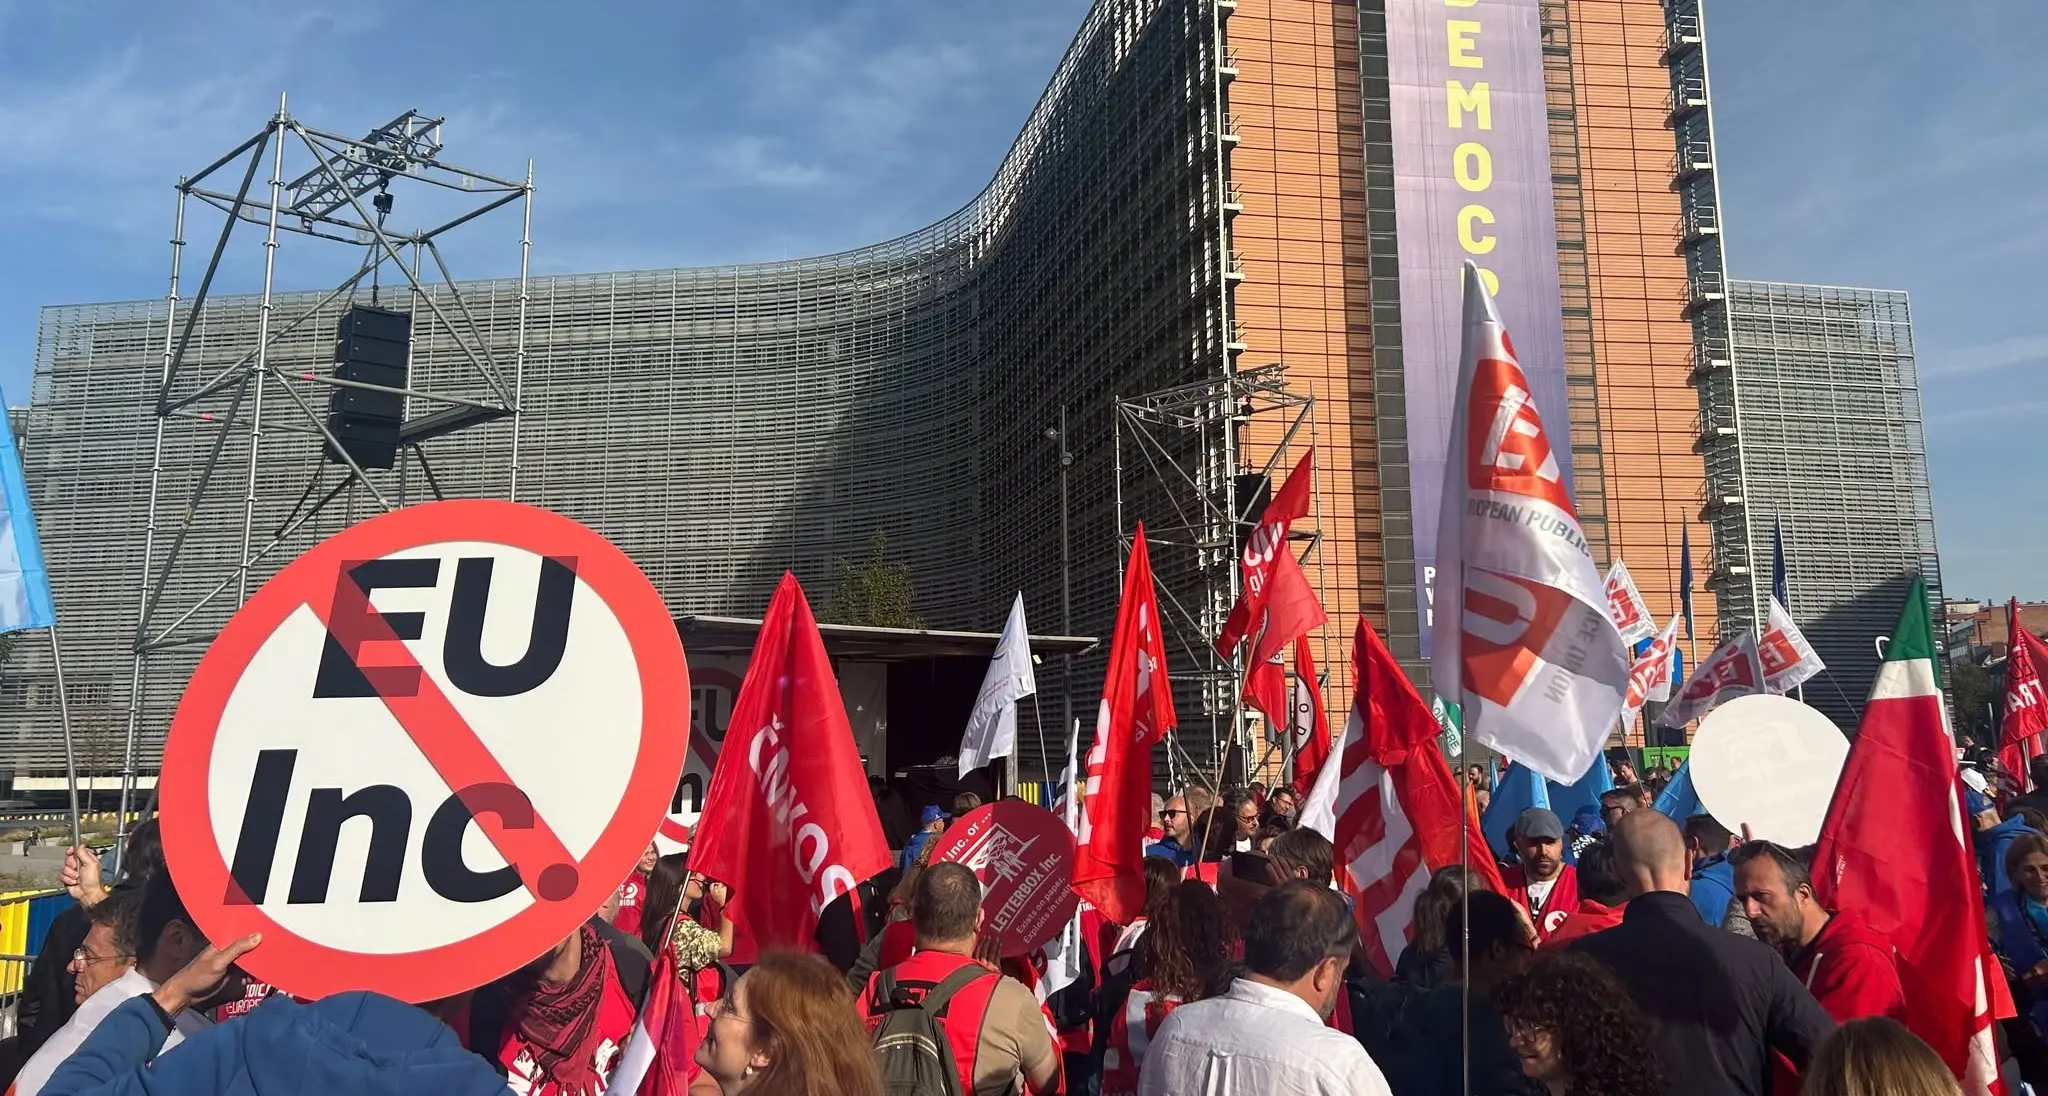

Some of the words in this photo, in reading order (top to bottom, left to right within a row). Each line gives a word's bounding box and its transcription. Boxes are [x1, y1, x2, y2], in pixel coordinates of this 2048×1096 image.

[312, 555, 579, 699] EU
[222, 748, 580, 906] Inc.
[967, 822, 980, 836] or
[989, 868, 1045, 933] LETTERBOX
[1038, 851, 1062, 873] Inc.
[1016, 909, 1038, 934] Exists
[1035, 899, 1046, 911] on
[1023, 912, 1051, 944] Exploits
[1047, 904, 1057, 914] in
